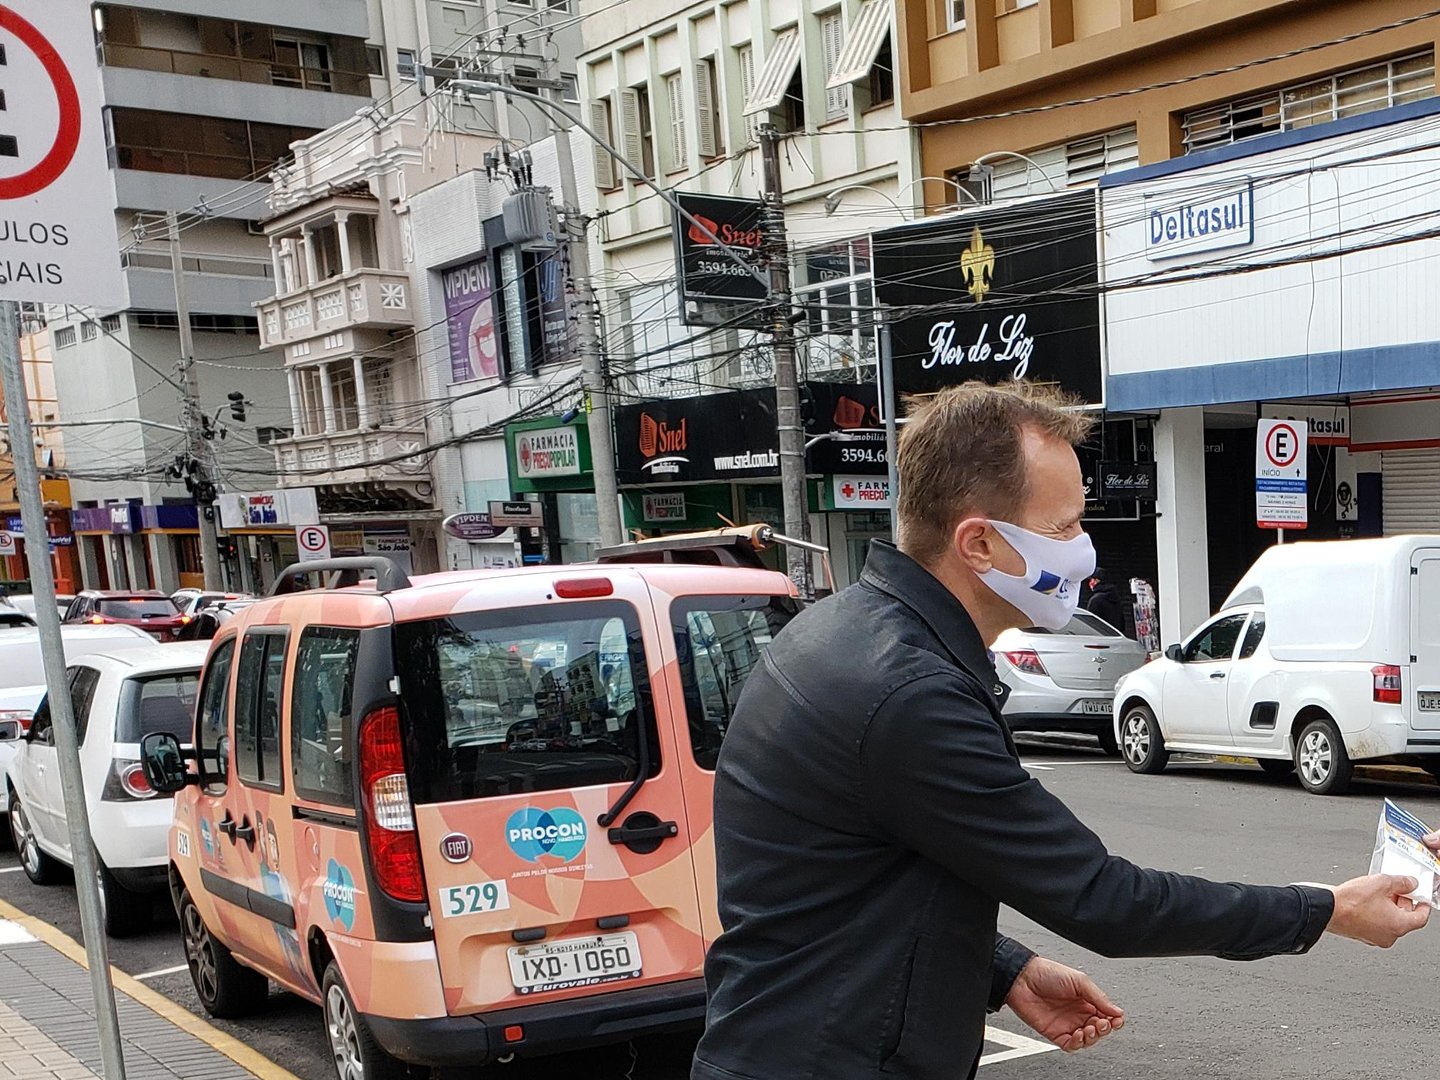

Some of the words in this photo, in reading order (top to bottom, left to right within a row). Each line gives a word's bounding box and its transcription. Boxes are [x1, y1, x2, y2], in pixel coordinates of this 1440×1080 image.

[1151, 192, 1243, 245] Deltasul
[922, 320, 964, 369] Flor
[968, 323, 991, 362] de
[994, 313, 1034, 380] Liz
[658, 417, 687, 452] Snel
[1287, 416, 1345, 434] ltasul
[531, 432, 575, 450] FARMÁCIA
[1276, 433, 1287, 457] E
[714, 449, 779, 470] www.snel.com.br
[453, 514, 488, 525] VIPDEN
[308, 533, 318, 546] E
[510, 822, 584, 842] PROCON
[448, 839, 467, 856] FIAT
[324, 881, 353, 903] PROCON
[450, 883, 498, 915] 529
